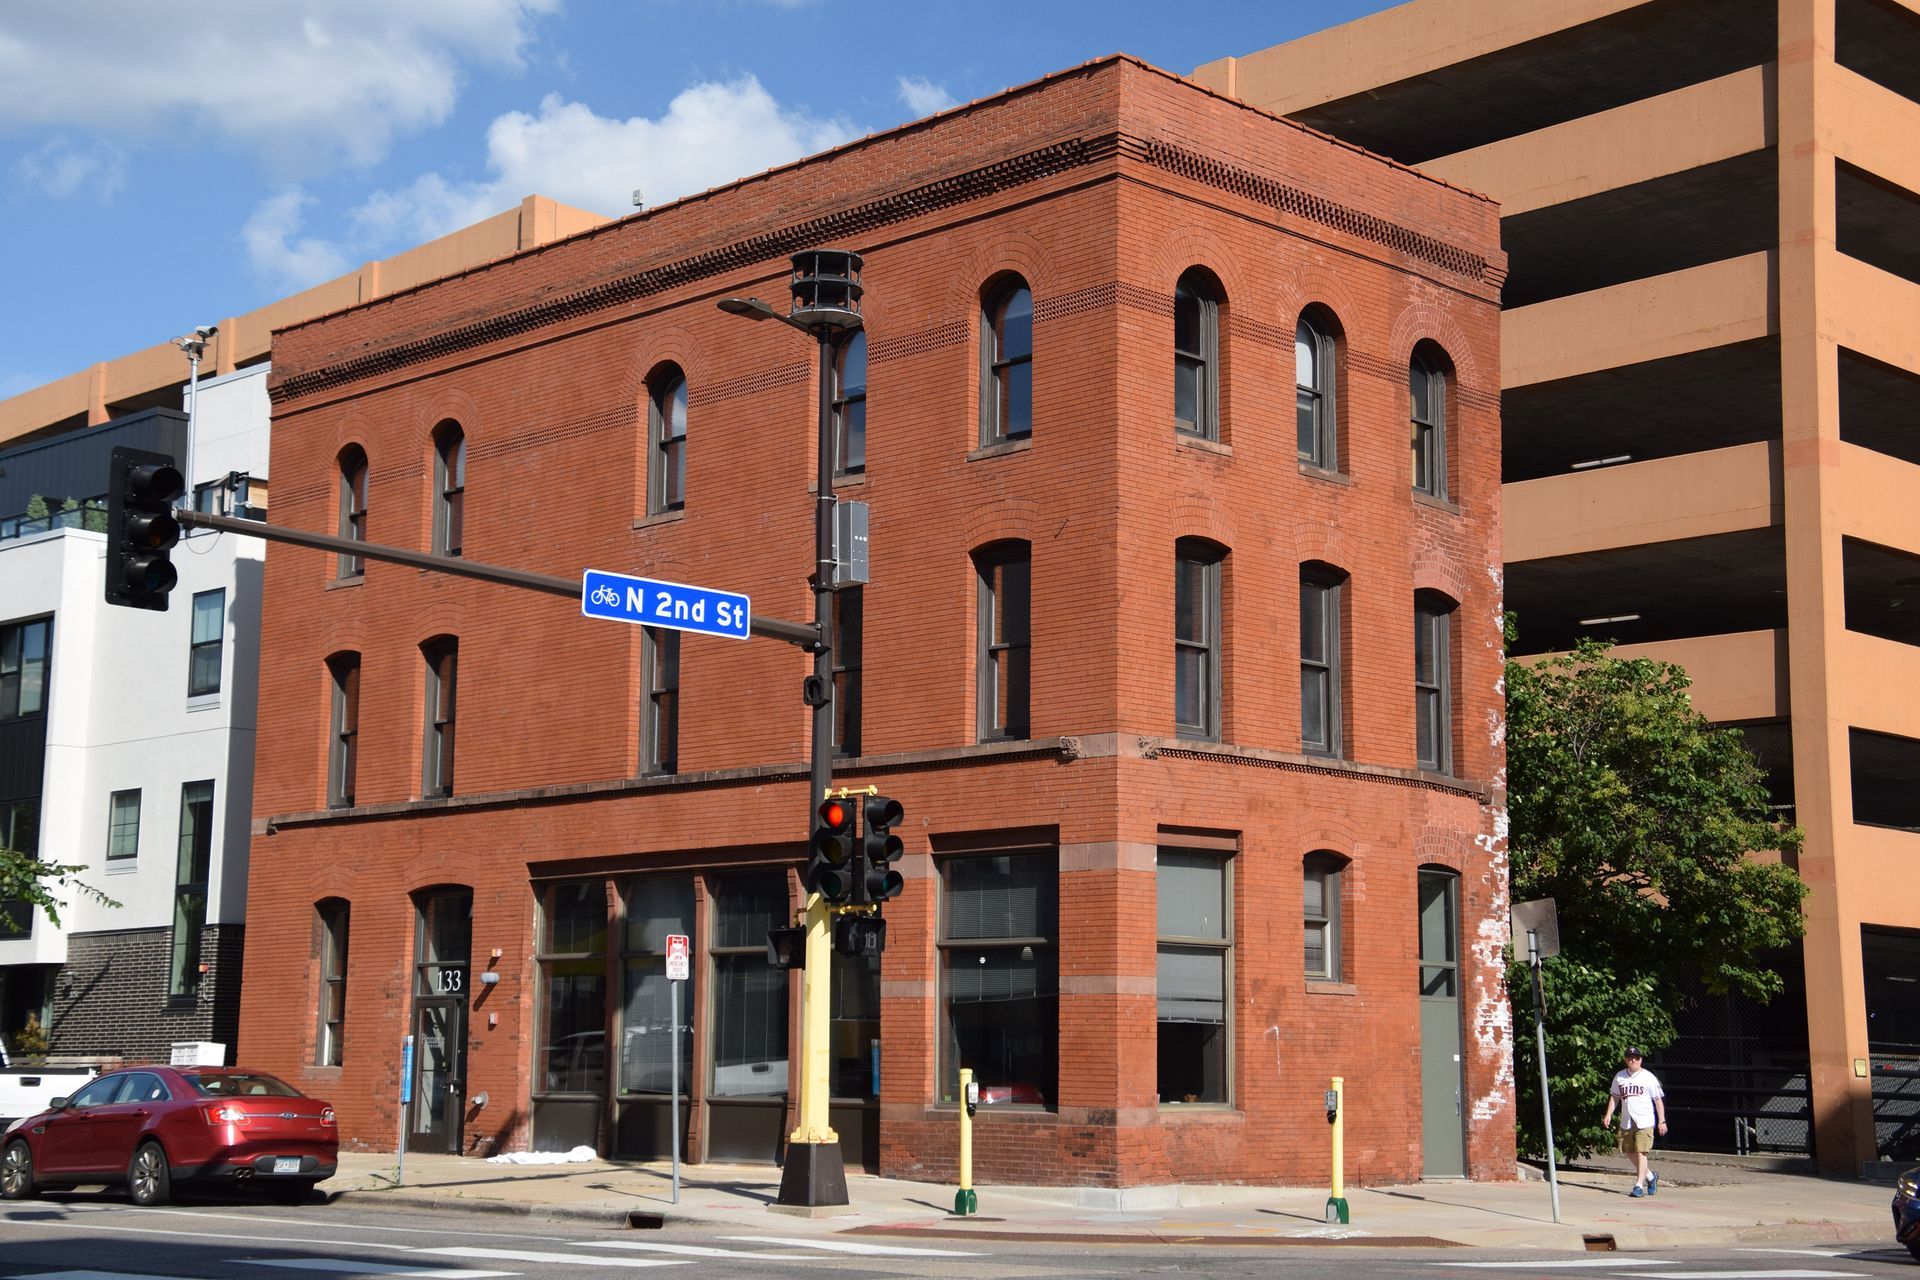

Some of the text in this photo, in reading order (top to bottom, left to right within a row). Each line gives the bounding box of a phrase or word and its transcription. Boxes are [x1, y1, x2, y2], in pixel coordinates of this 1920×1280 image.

[626, 587, 744, 629] N 2nd St
[437, 970, 461, 991] 133
